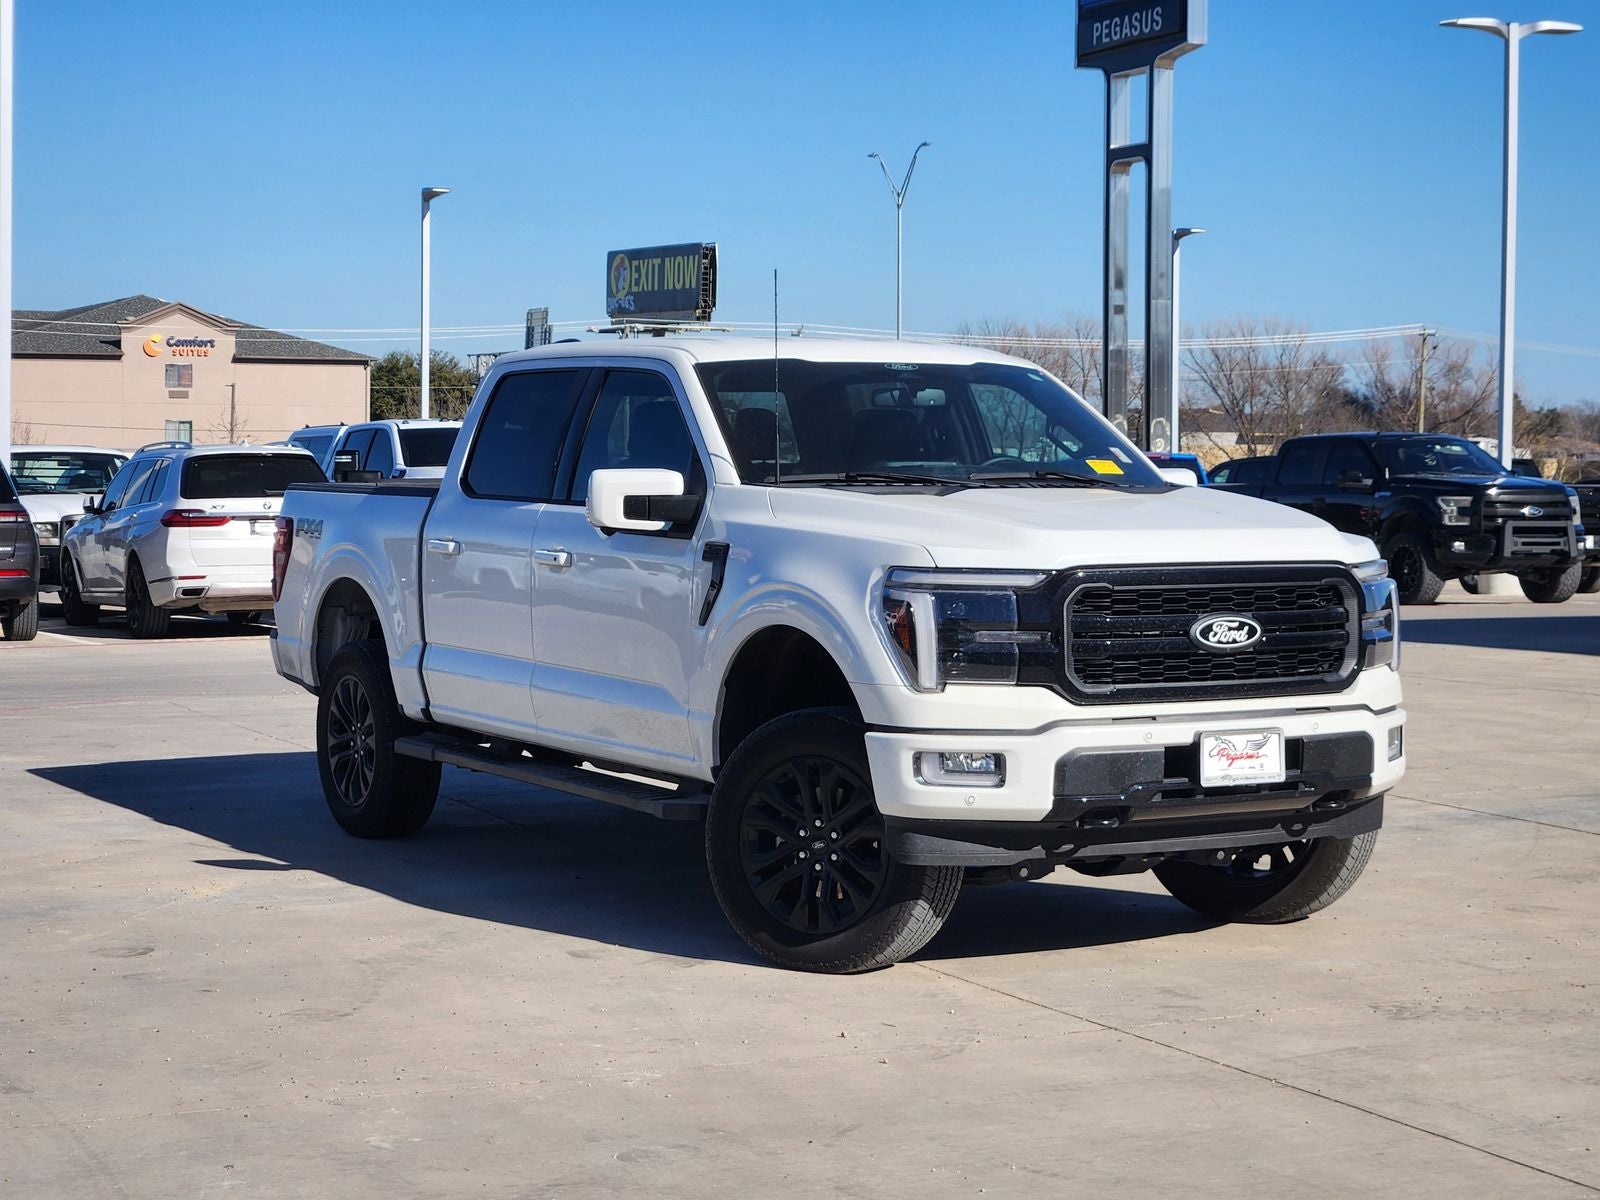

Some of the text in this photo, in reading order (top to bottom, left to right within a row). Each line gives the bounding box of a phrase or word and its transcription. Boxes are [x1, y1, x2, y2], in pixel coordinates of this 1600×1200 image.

[1093, 6, 1162, 46] PEGASUS
[631, 254, 699, 292] EXIT NOW
[166, 335, 216, 348] Comfort
[172, 348, 209, 357] SUITES
[295, 518, 323, 537] FX4
[1208, 621, 1249, 643] Ford
[1216, 747, 1268, 768] Pegasus
